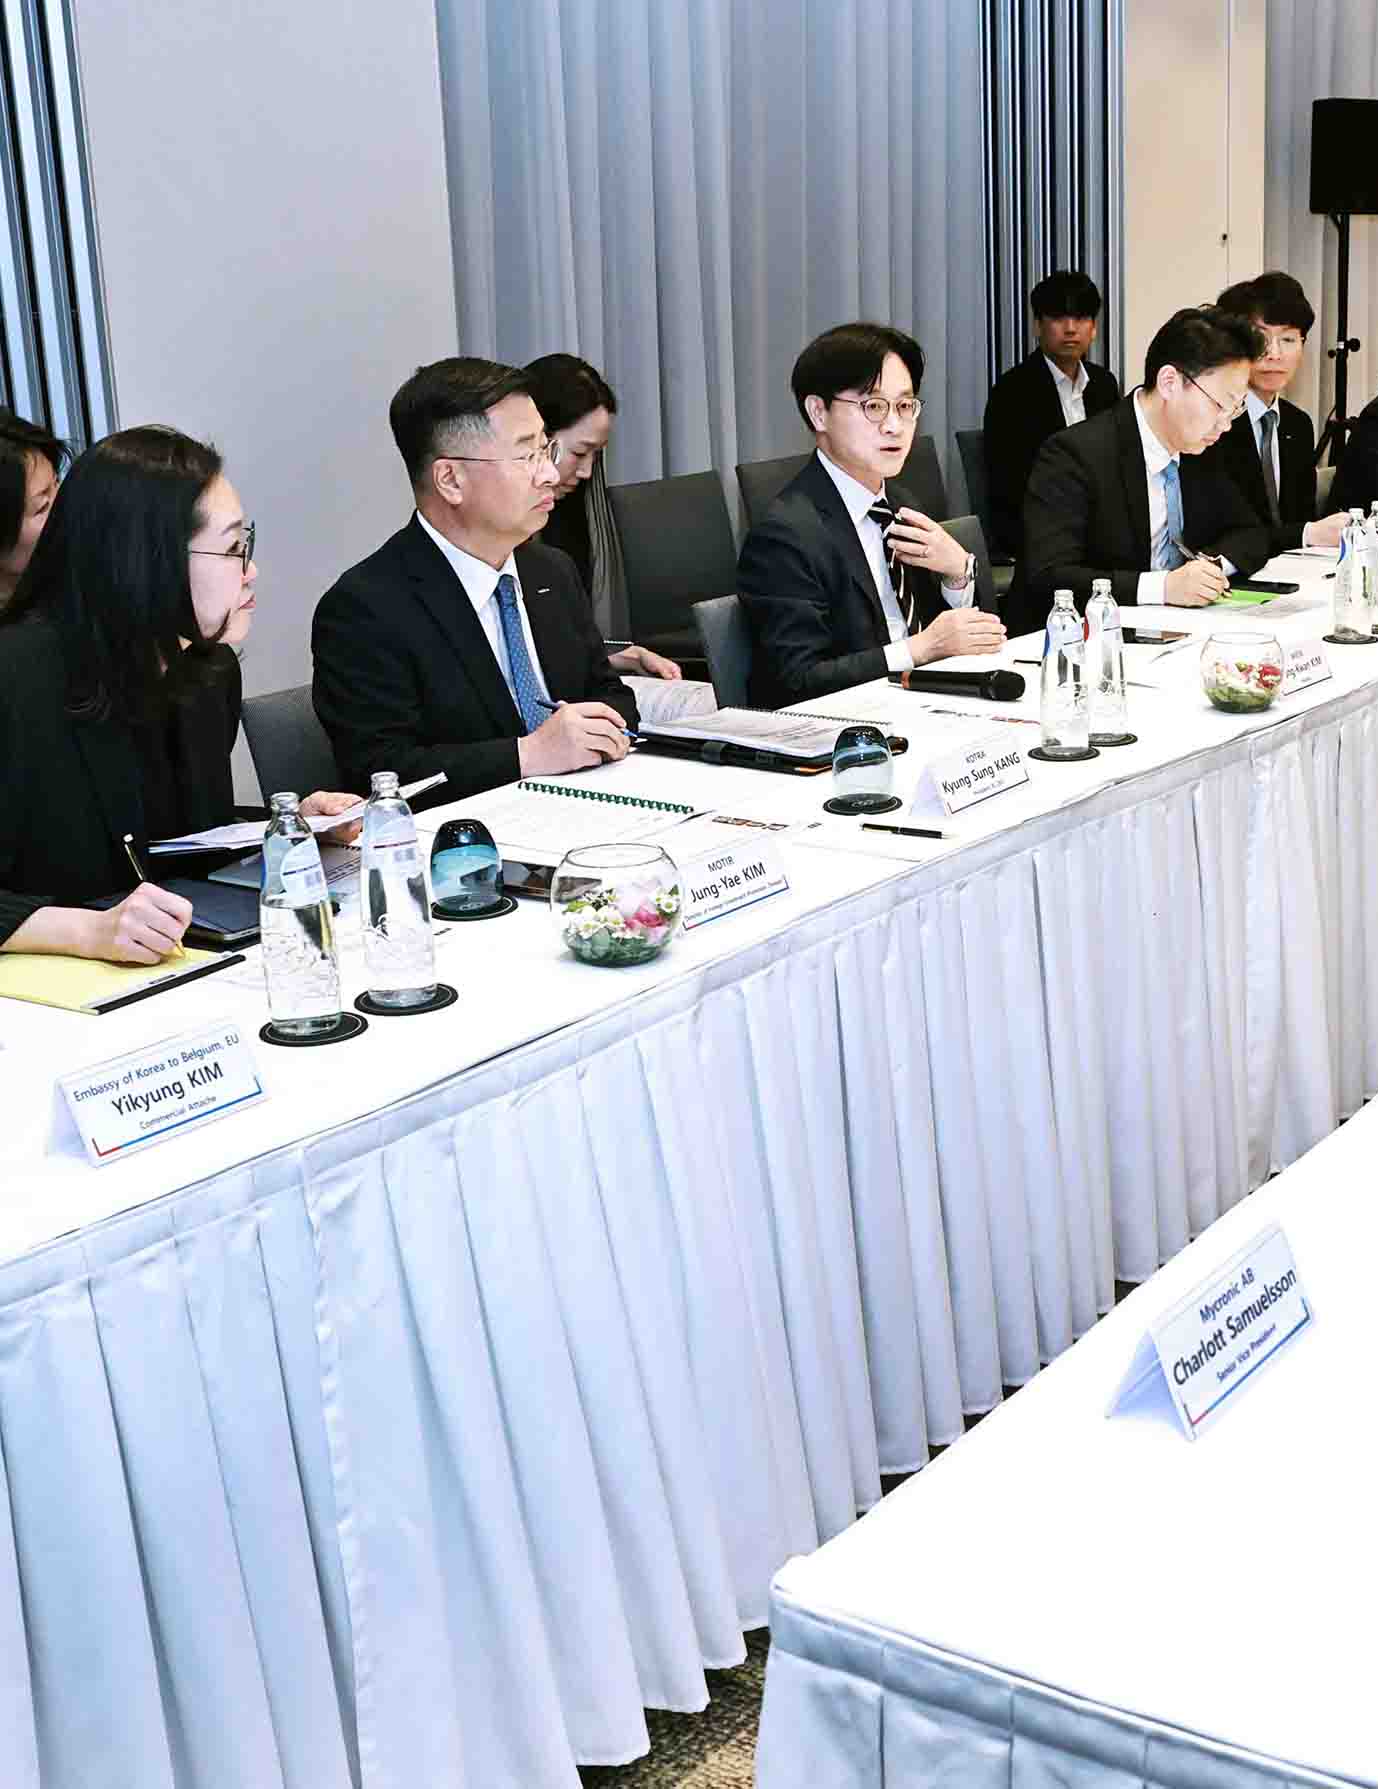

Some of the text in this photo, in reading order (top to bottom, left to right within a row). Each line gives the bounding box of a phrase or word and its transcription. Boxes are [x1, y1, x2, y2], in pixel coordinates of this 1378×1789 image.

[942, 776, 971, 794] Kyung
[971, 766, 994, 780] Sung
[994, 752, 1020, 770] KANG
[691, 875, 741, 902] Jung-Yae
[742, 862, 766, 880] KIM
[708, 855, 734, 873] MOTIR
[74, 1080, 120, 1102] Embassy
[122, 1071, 134, 1085] of
[136, 1063, 166, 1078] Korea
[168, 1057, 180, 1068] to
[225, 1033, 240, 1047] EU
[112, 1061, 225, 1117] Yikyung KIM
[1199, 1267, 1255, 1323] Mycronic AB
[1173, 1269, 1297, 1385] Charlott Samuelsson
